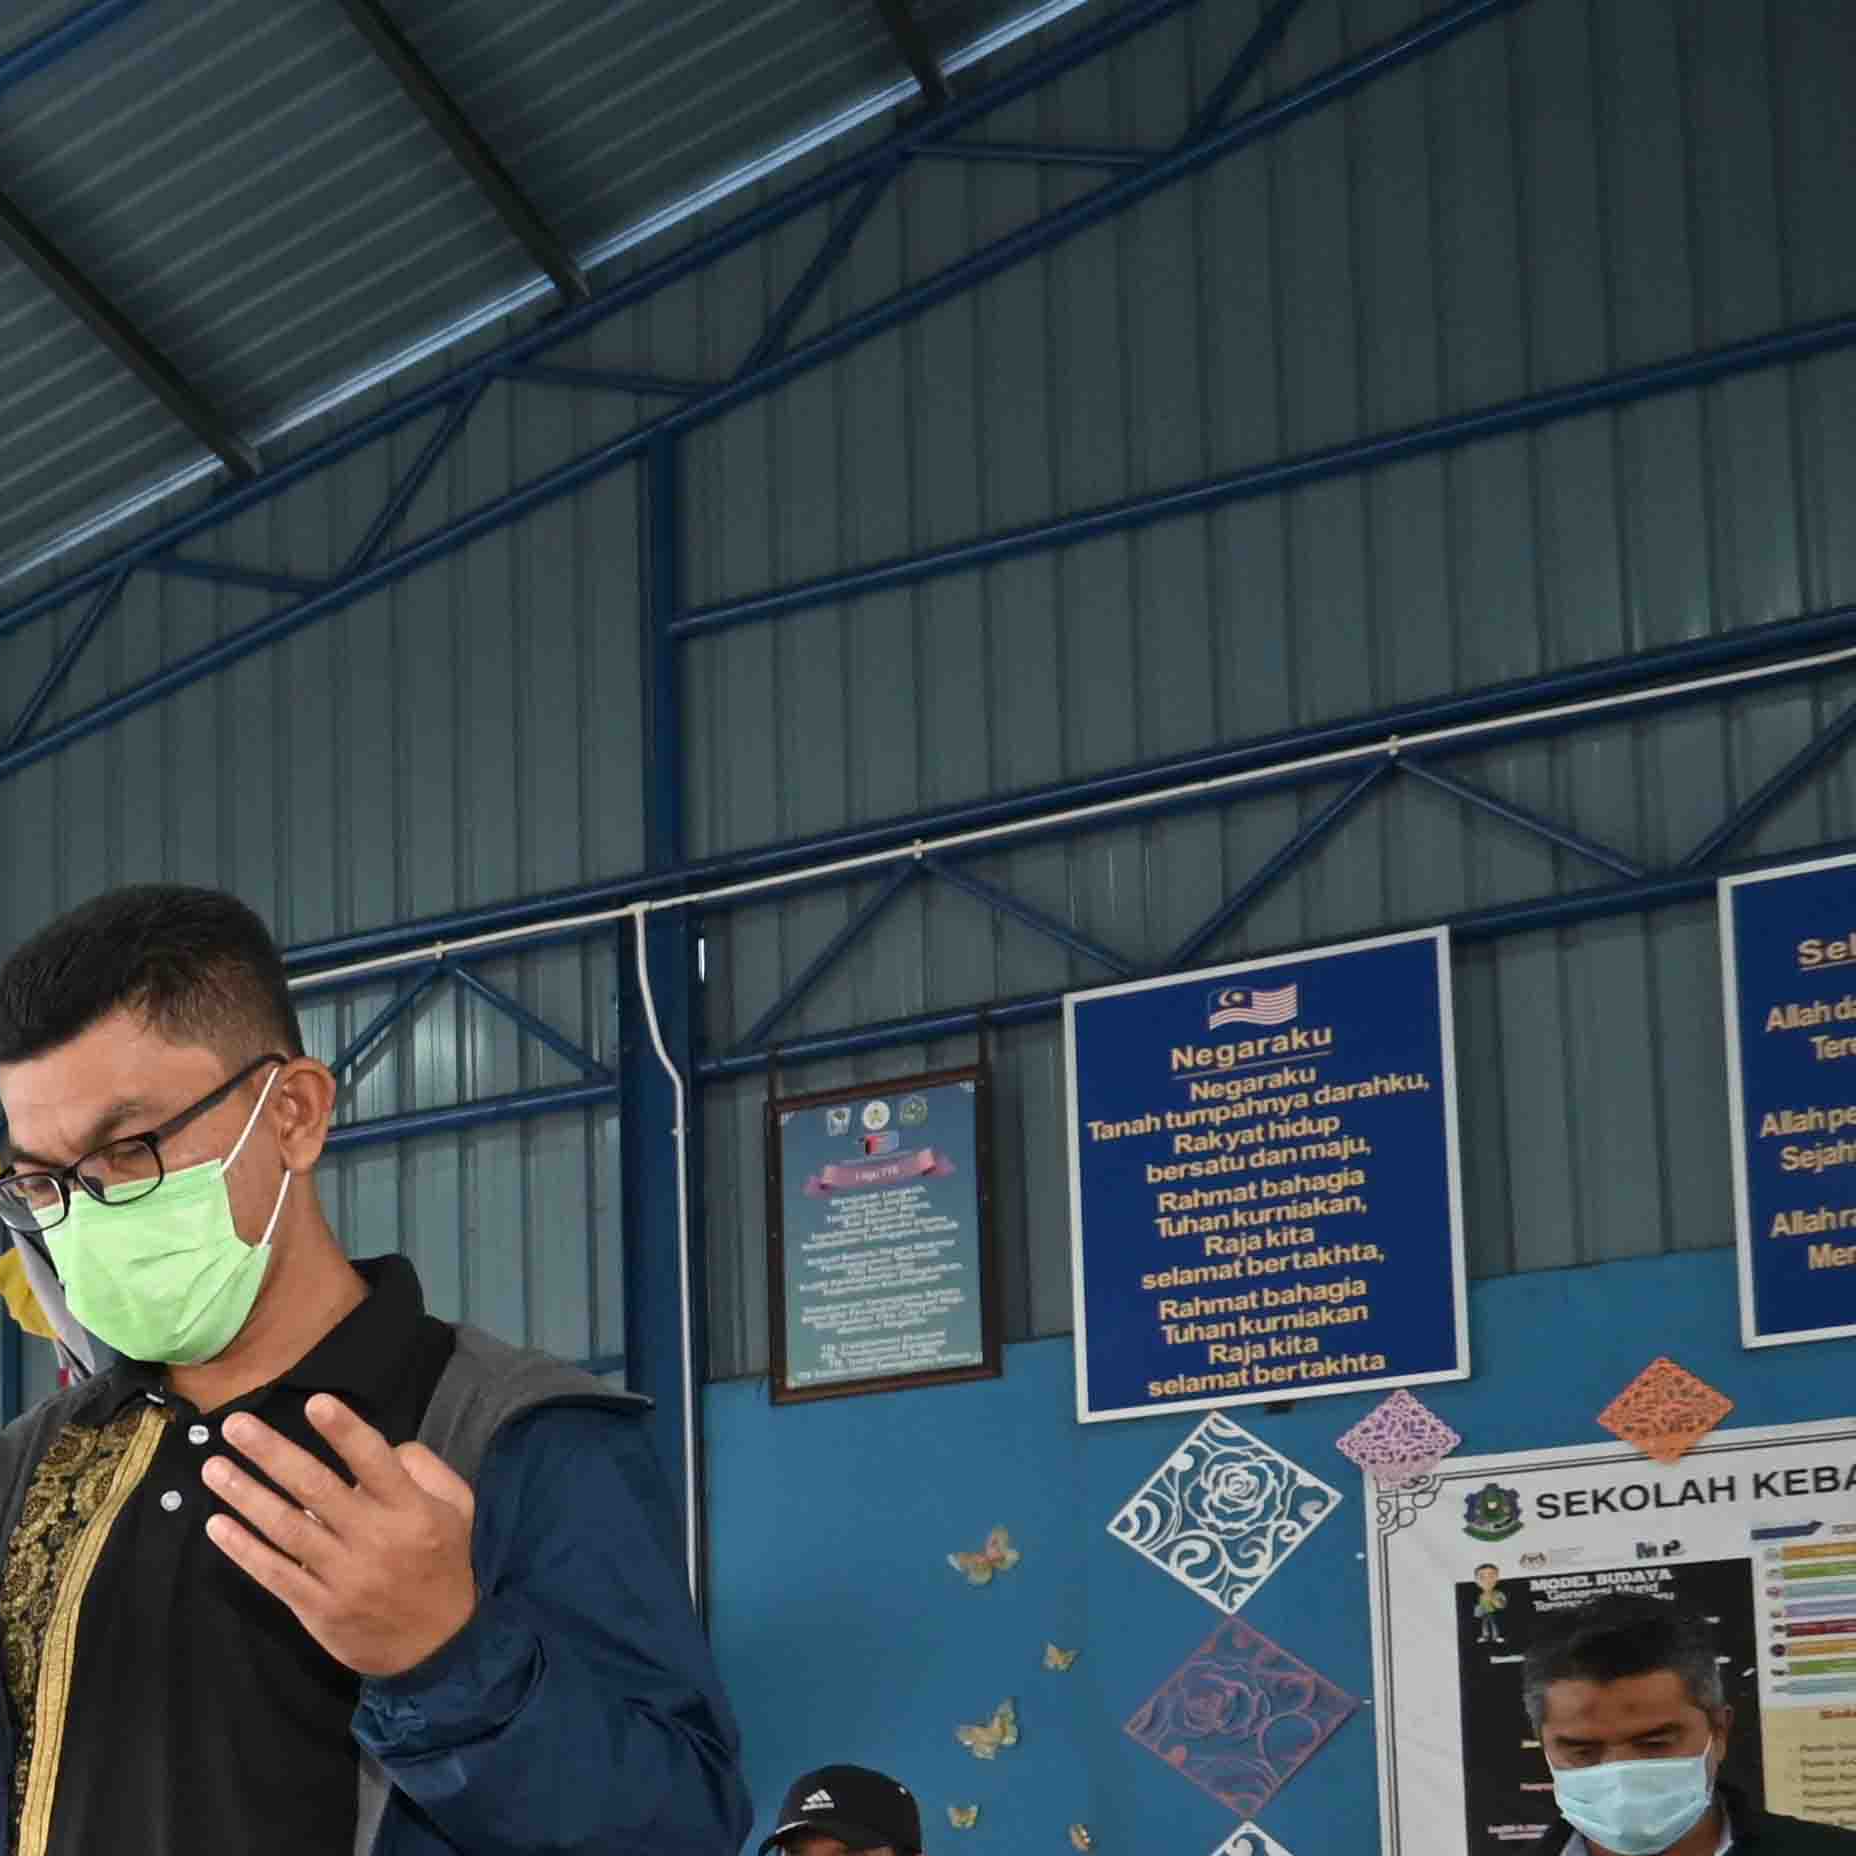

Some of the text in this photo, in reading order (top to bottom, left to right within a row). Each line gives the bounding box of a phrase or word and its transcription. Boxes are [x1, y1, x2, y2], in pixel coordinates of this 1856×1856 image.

[1765, 1000, 1832, 1032] Allah
[1170, 1027, 1333, 1071] Negaraku
[1190, 1066, 1317, 1101] Negaraku
[1087, 1072, 1430, 1142] Tanah tumpahnya darahku,
[1759, 1106, 1825, 1139] Allah
[1173, 1114, 1340, 1154] Rakyat hidup
[1146, 1135, 1372, 1184] bersatu dan maju,
[1781, 1139, 1856, 1173] Sejah
[1157, 1167, 1366, 1212] Rahmat bahagia
[1155, 1193, 1368, 1238] Tuhan kurniakan,
[1770, 1206, 1837, 1239] Allah
[1204, 1226, 1315, 1256] Raja kita
[1141, 1259, 1244, 1289] selamat
[1158, 1276, 1367, 1321] Rahmat bahagia
[1161, 1304, 1369, 1345] Tuhan kurniakan
[1208, 1335, 1320, 1365] Raja kita
[1148, 1368, 1249, 1398] selamat
[1535, 1474, 1737, 1520] SEKOLAH
[1529, 1568, 1674, 1592] MODEL BUDAYA
